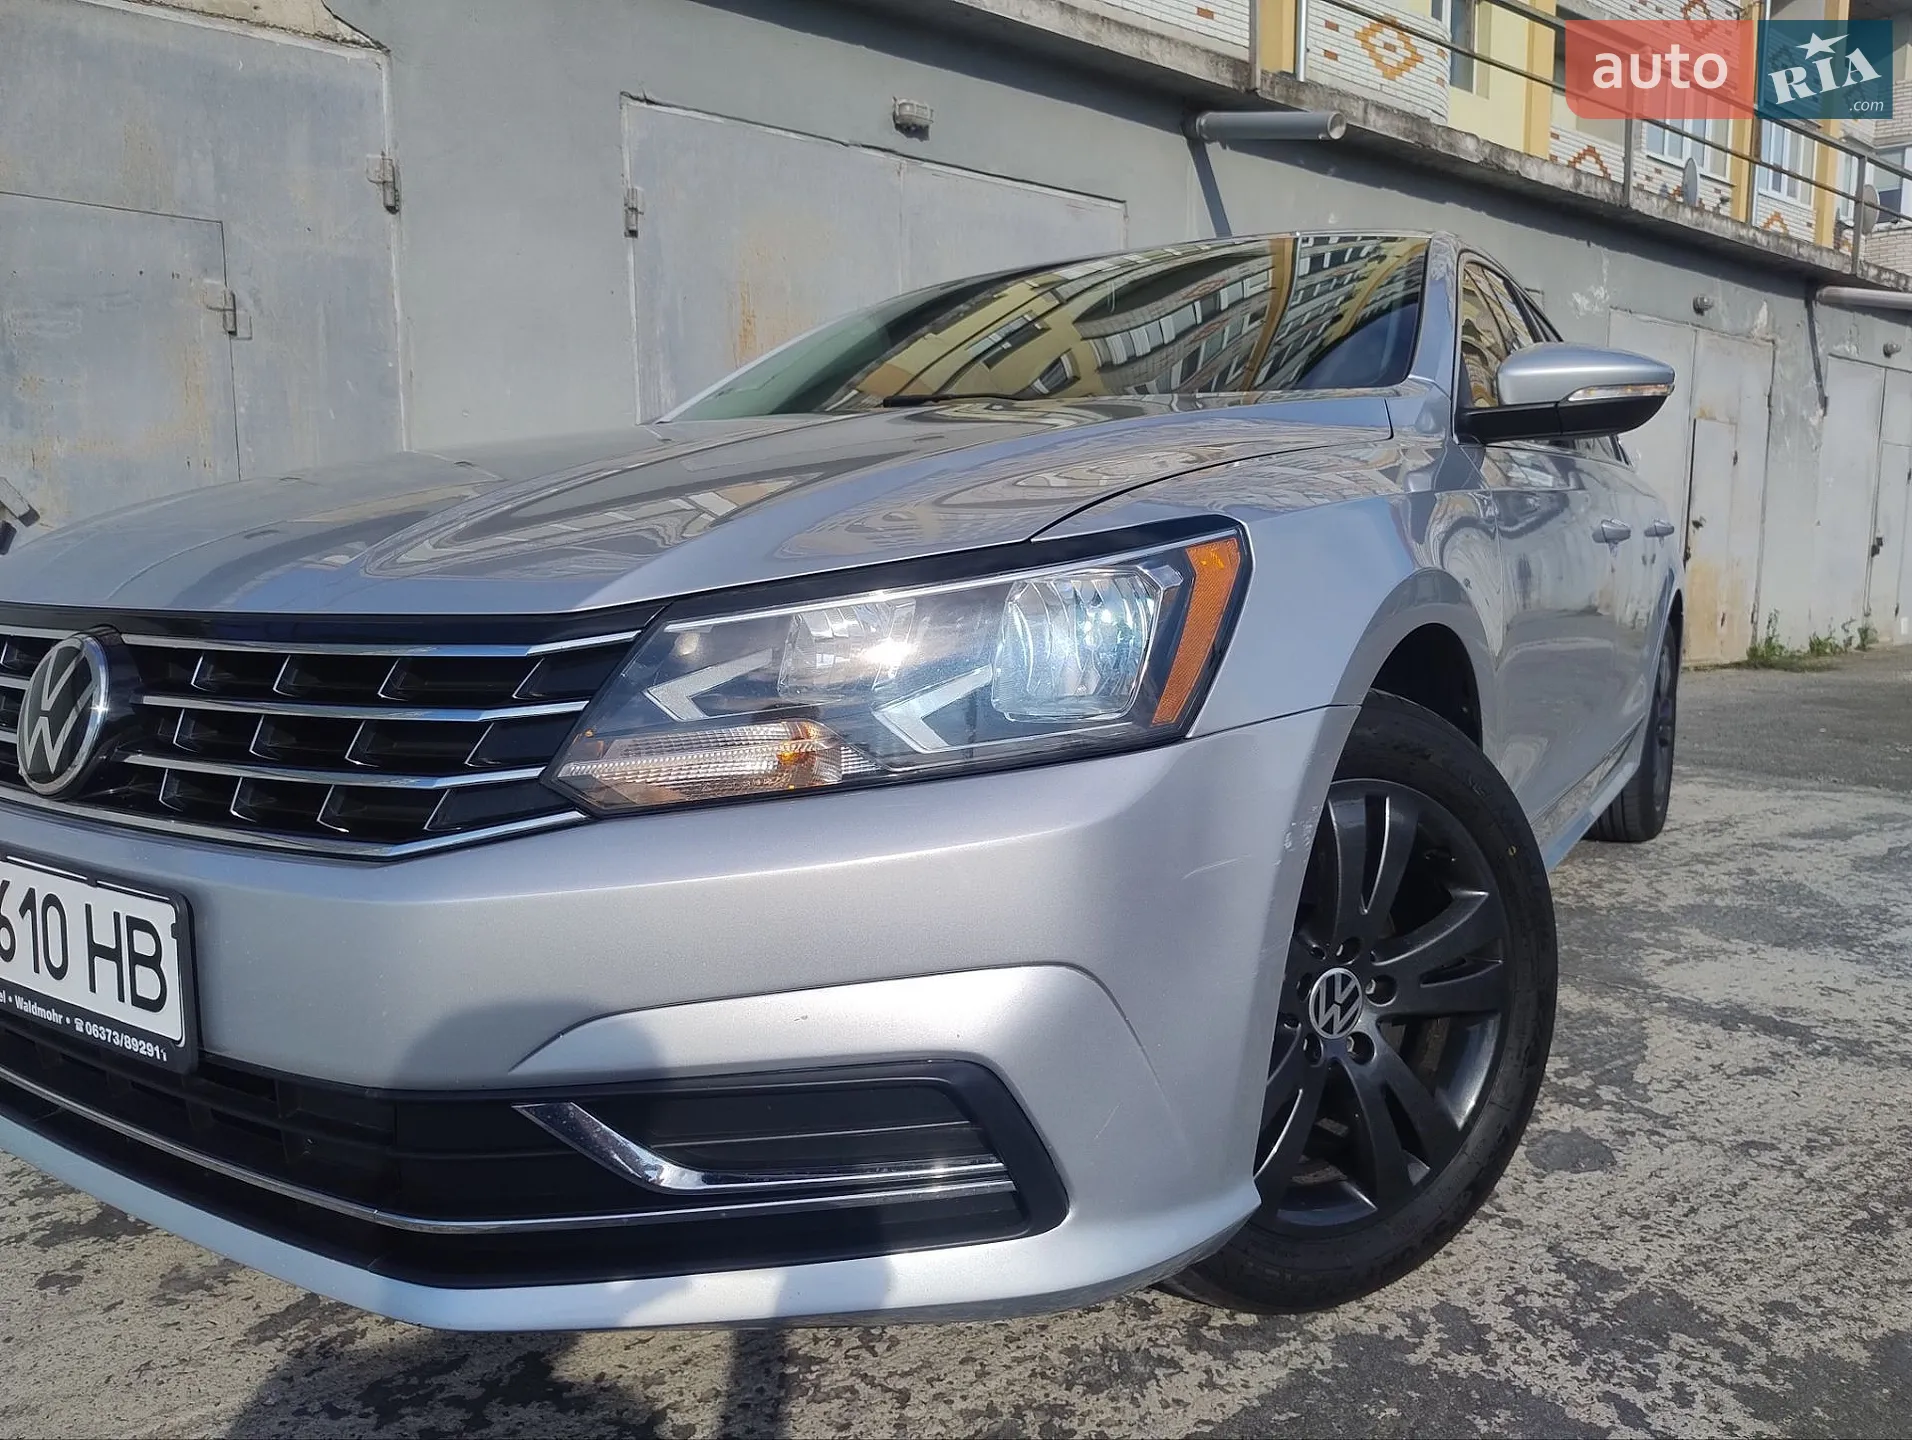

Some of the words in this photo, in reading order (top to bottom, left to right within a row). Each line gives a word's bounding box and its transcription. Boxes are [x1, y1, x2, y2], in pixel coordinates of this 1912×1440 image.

[22, 640, 98, 778] VW
[84, 902, 168, 1014] HB
[14, 994, 63, 1025] Waldmohr
[1315, 970, 1362, 1037] VW
